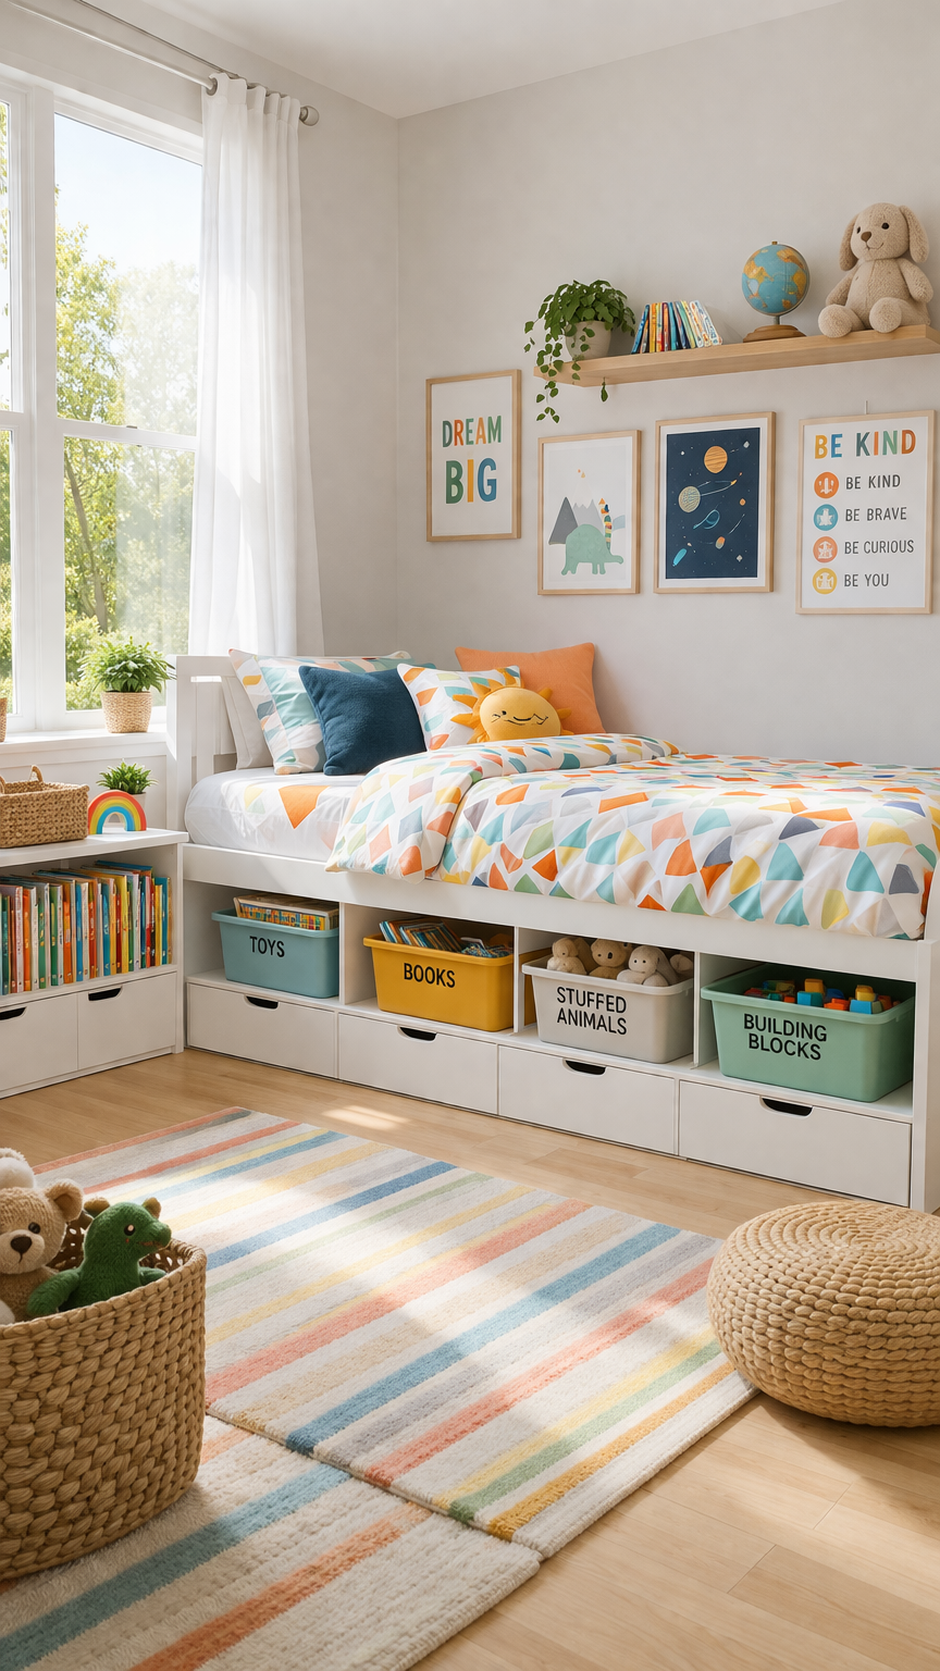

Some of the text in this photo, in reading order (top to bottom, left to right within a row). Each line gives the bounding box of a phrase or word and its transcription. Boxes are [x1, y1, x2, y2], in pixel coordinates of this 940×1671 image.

[442, 415, 502, 447] DREAM
[815, 429, 917, 459] BE KIND
[445, 458, 497, 504] BIG
[845, 475, 901, 490] BE KIND
[845, 507, 907, 522] BE BRAVE
[844, 540, 915, 555] BE CURIOUS
[844, 574, 889, 588] BE YOU
[249, 936, 285, 957] TOYS
[403, 963, 456, 988] BOOKS
[557, 987, 627, 1014] STUFFED
[557, 1007, 627, 1035] ANIMALS
[744, 1013, 827, 1042] BUILDING
[749, 1033, 821, 1061] BLOCKS
